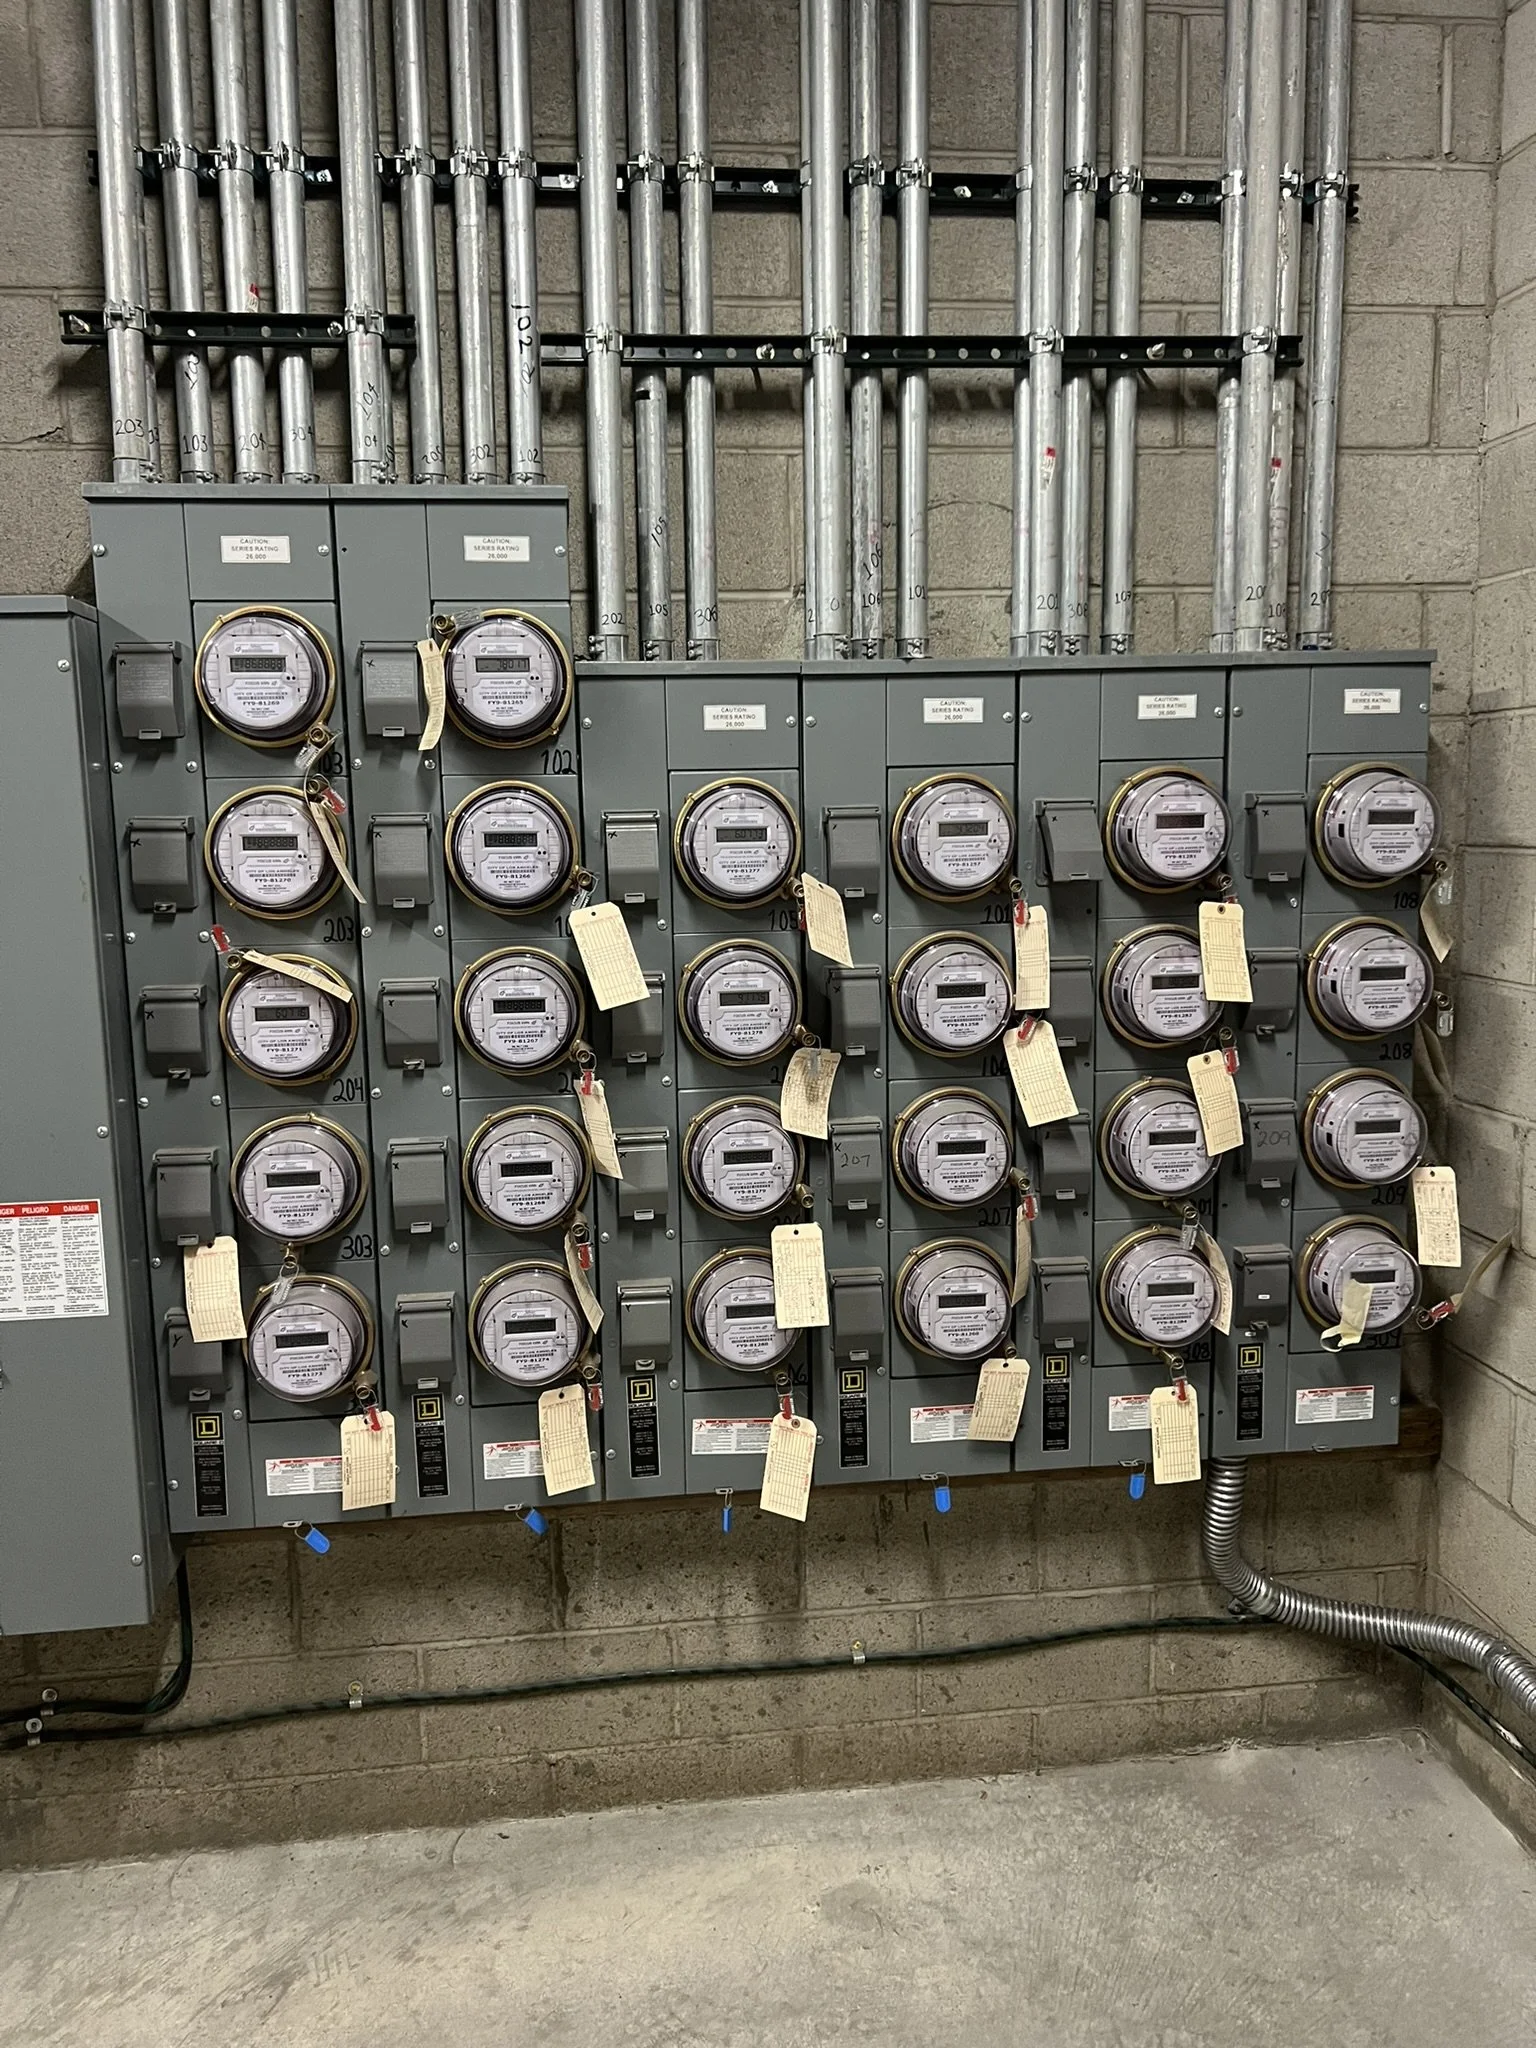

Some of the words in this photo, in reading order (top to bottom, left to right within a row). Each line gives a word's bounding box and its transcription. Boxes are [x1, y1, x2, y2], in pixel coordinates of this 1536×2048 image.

[511, 304, 533, 354] 102
[115, 419, 145, 438] 203
[183, 435, 208, 455] 103
[470, 444, 494, 464] 302
[909, 585, 927, 600] 101
[602, 613, 625, 626] 202
[650, 604, 669, 617] 105
[541, 748, 577, 775] 102
[1393, 892, 1420, 909] 108
[324, 915, 354, 942] 203
[1379, 1042, 1412, 1061] 208
[333, 1077, 364, 1102] 204
[1257, 1130, 1291, 1147] 209
[840, 1153, 871, 1168] 207
[1371, 1185, 1408, 1205] 209
[22, 1206, 50, 1214] PELIGRO
[63, 1204, 90, 1213] DANGER
[977, 1207, 1011, 1226] 207
[341, 1234, 372, 1260] 303
